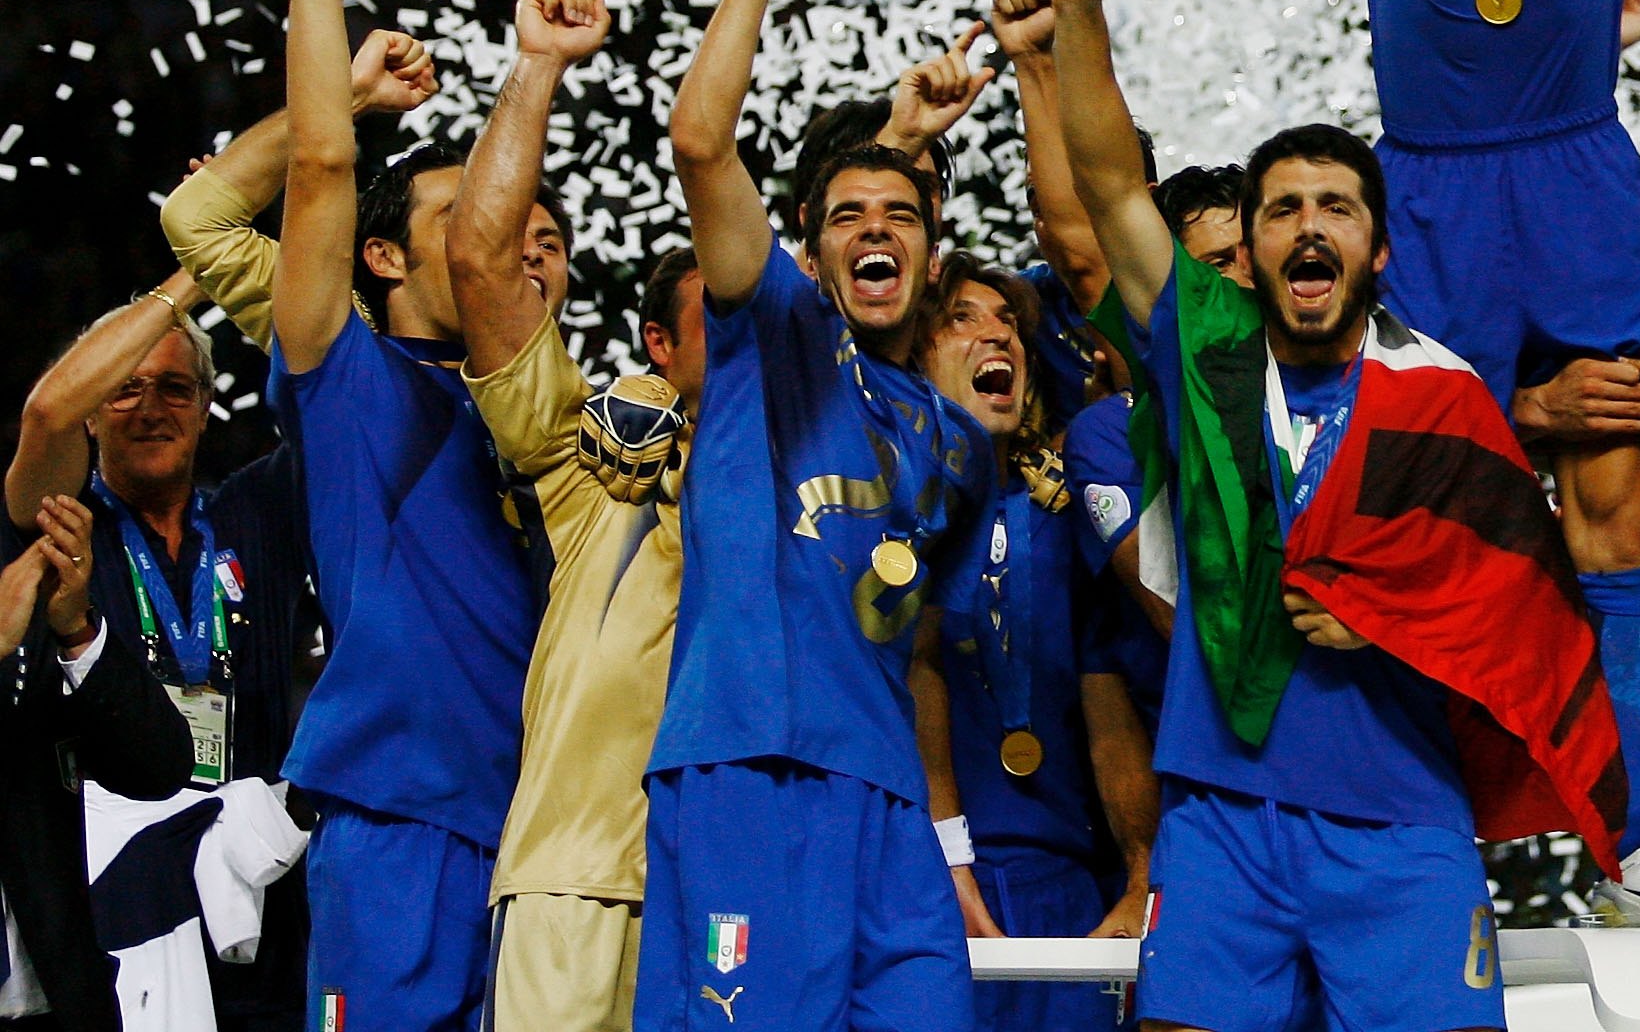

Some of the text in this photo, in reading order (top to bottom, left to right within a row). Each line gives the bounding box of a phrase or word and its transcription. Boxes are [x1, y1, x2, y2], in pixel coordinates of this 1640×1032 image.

[1334, 406, 1349, 426] FIFA
[1294, 484, 1310, 504] FIFA
[711, 914, 746, 923] ITALIA
[1463, 904, 1496, 989] 8
